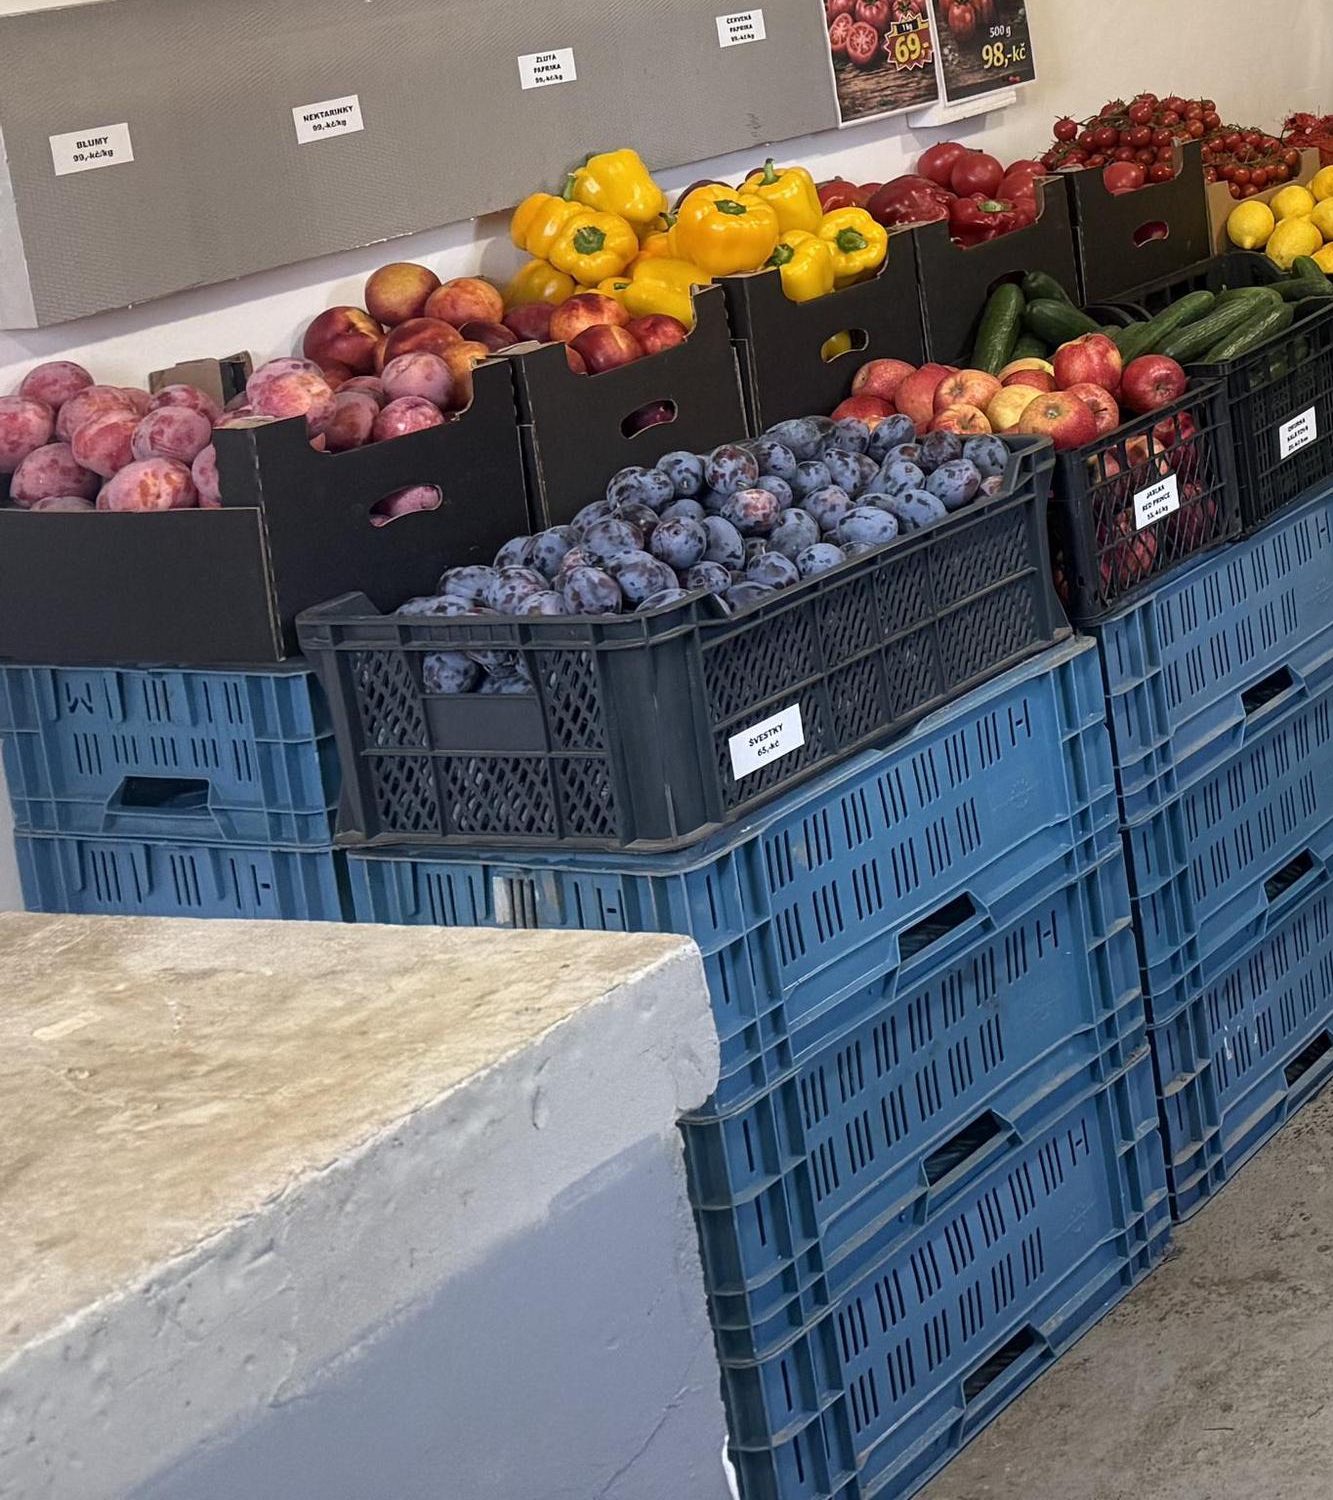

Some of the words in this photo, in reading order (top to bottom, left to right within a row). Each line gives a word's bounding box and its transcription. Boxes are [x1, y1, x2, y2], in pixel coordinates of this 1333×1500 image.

[989, 25, 1005, 38] 500
[1006, 26, 1011, 37] g
[894, 33, 929, 64] 69,-
[981, 42, 1026, 69] 98,-kč
[534, 63, 561, 74] PAPRIKA
[302, 105, 354, 122] NEKTARINKY
[76, 136, 109, 150] BLUMY
[748, 723, 783, 747] ŠVESTKY
